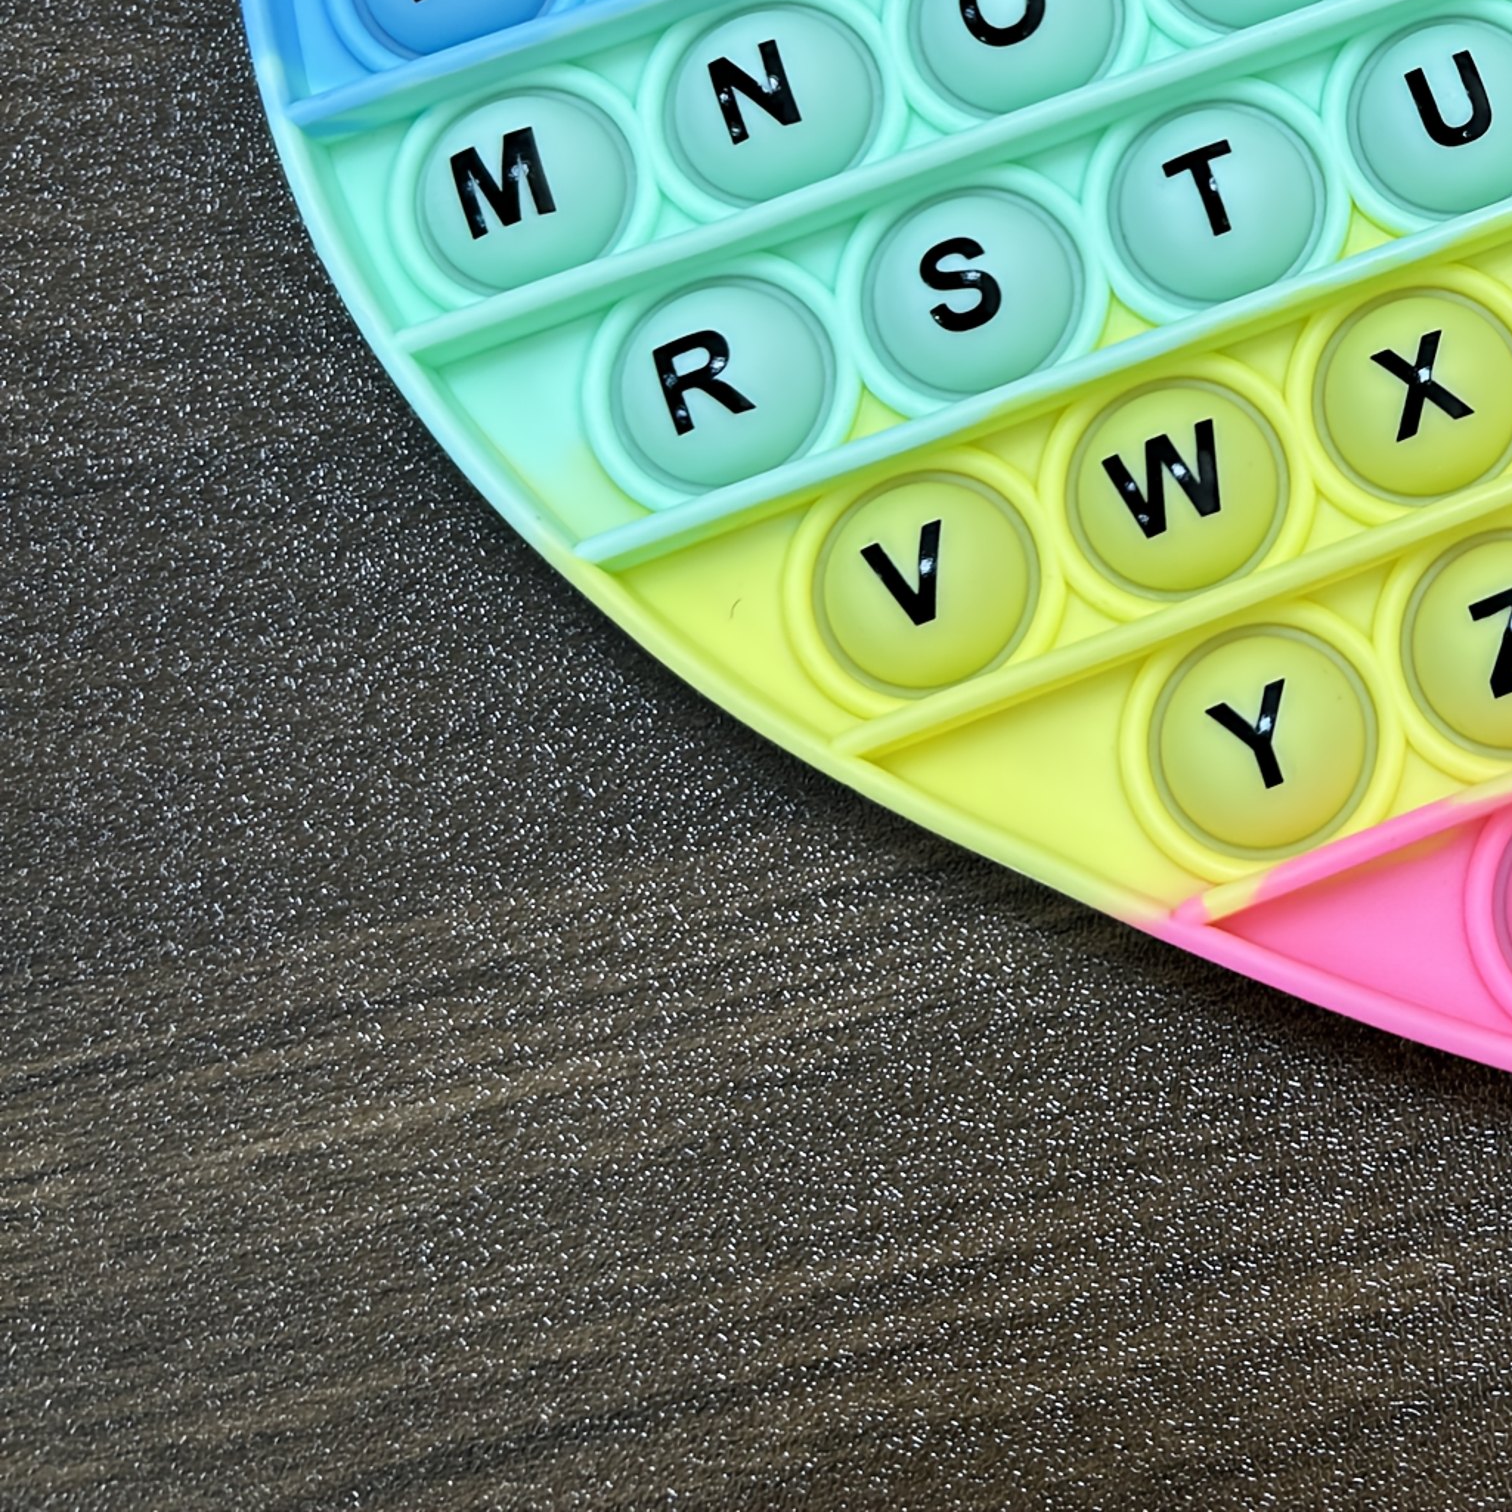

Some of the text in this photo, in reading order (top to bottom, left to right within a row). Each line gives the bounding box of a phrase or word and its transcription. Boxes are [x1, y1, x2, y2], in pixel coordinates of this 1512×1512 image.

[449, 126, 557, 240] M
[707, 39, 802, 145] N
[652, 330, 756, 436] R
[919, 237, 1002, 333] S
[1161, 139, 1232, 237] T
[1403, 49, 1492, 147] U
[860, 519, 942, 626] V
[1101, 418, 1221, 539] W
[1370, 329, 1475, 443] X
[1204, 678, 1285, 789] Y
